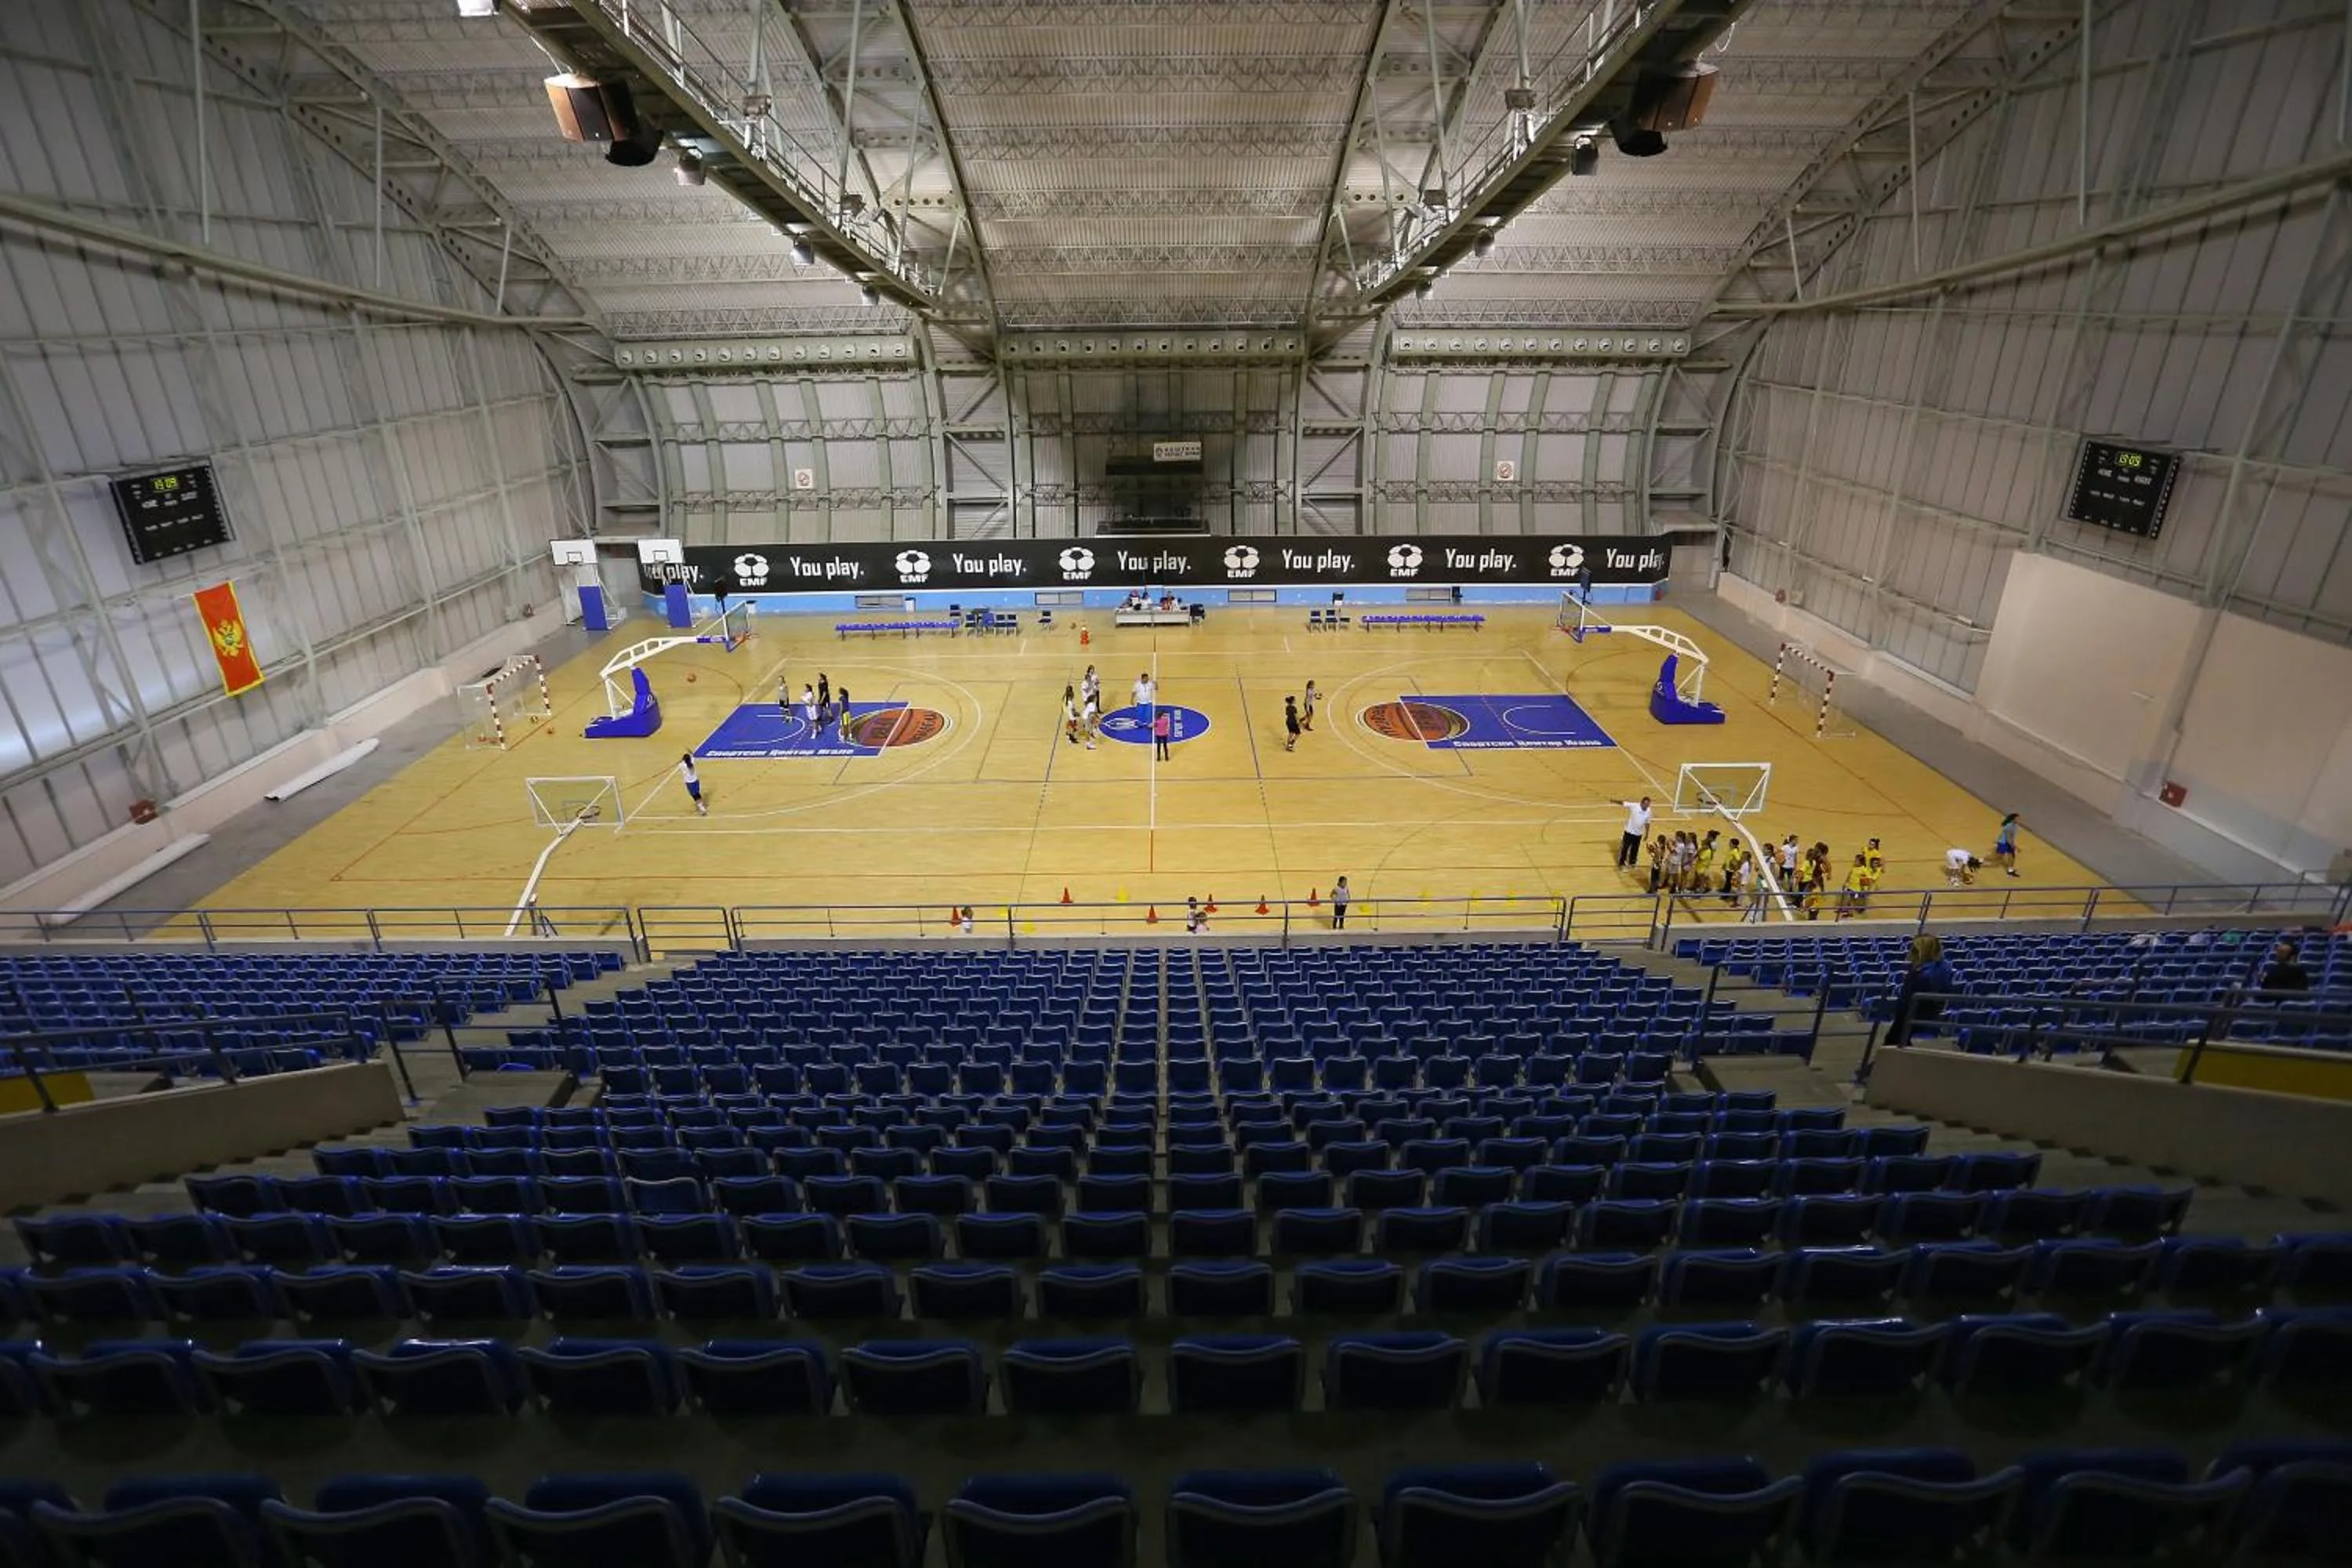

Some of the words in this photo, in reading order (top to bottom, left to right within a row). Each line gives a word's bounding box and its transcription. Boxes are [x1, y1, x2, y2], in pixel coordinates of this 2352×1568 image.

[790, 556, 822, 576] You
[826, 557, 866, 580] play.
[953, 554, 984, 573] You
[989, 554, 1028, 577] play.
[1118, 551, 1149, 571] You
[1154, 550, 1191, 575] play.
[1283, 550, 1312, 569] You
[1317, 549, 1356, 573] play.
[1446, 549, 1475, 568] You
[1479, 549, 1517, 572] play.
[1606, 549, 1635, 568] You
[899, 574, 928, 583] EMF
